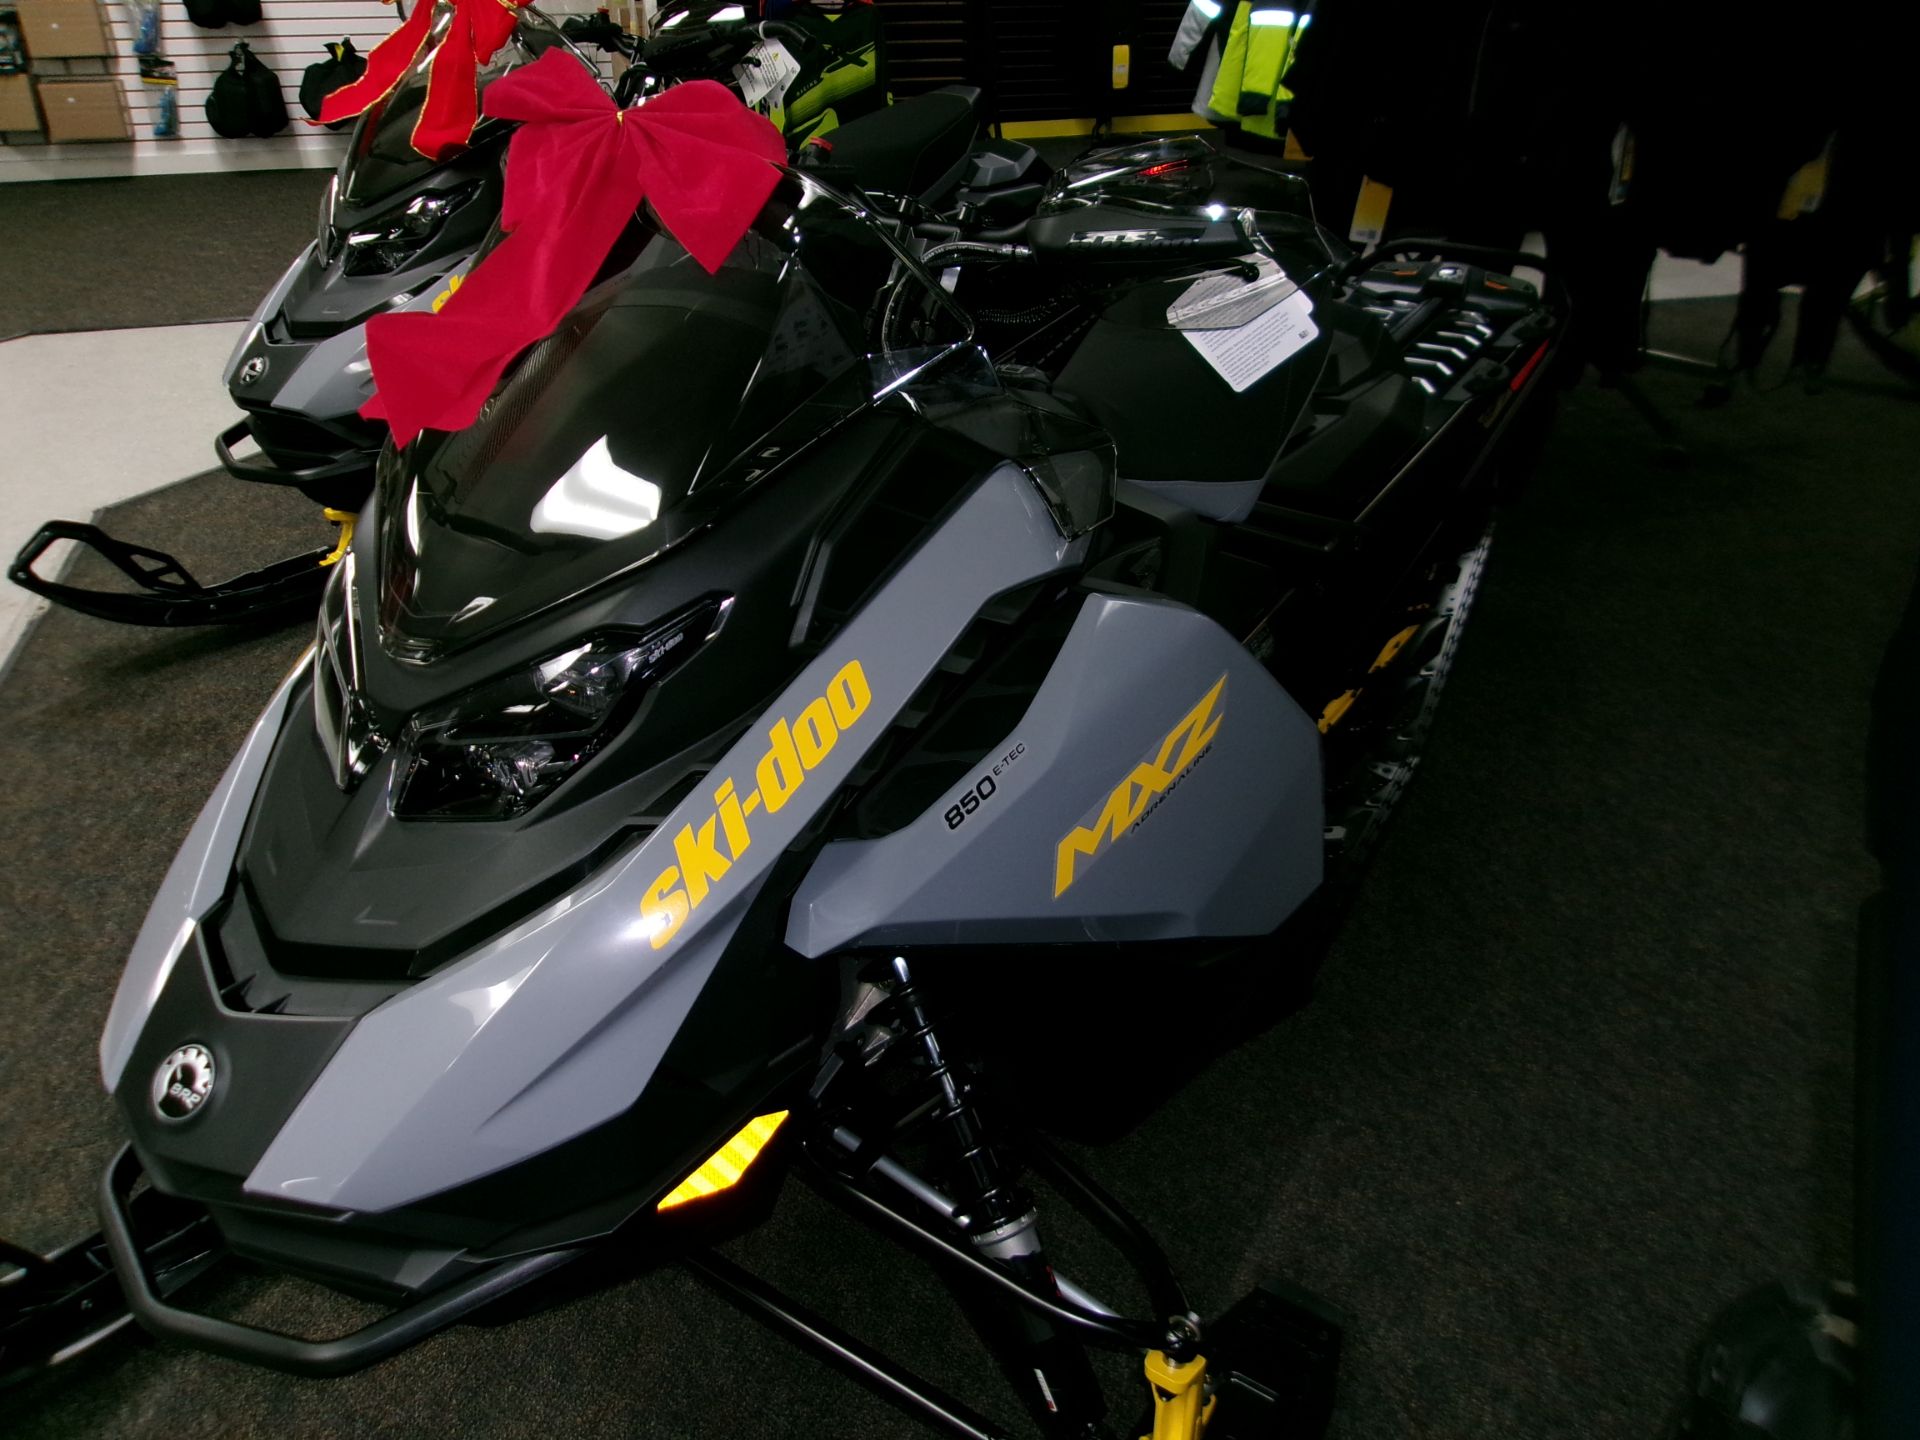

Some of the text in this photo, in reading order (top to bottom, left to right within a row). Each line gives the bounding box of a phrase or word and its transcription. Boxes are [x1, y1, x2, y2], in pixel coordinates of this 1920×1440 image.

[640, 659, 872, 950] ski-doo
[944, 743, 1025, 830] 850 E-TEC
[1054, 672, 1228, 899] MXZ
[1131, 743, 1213, 834] ADRENALINE
[169, 1081, 202, 1110] BRP
